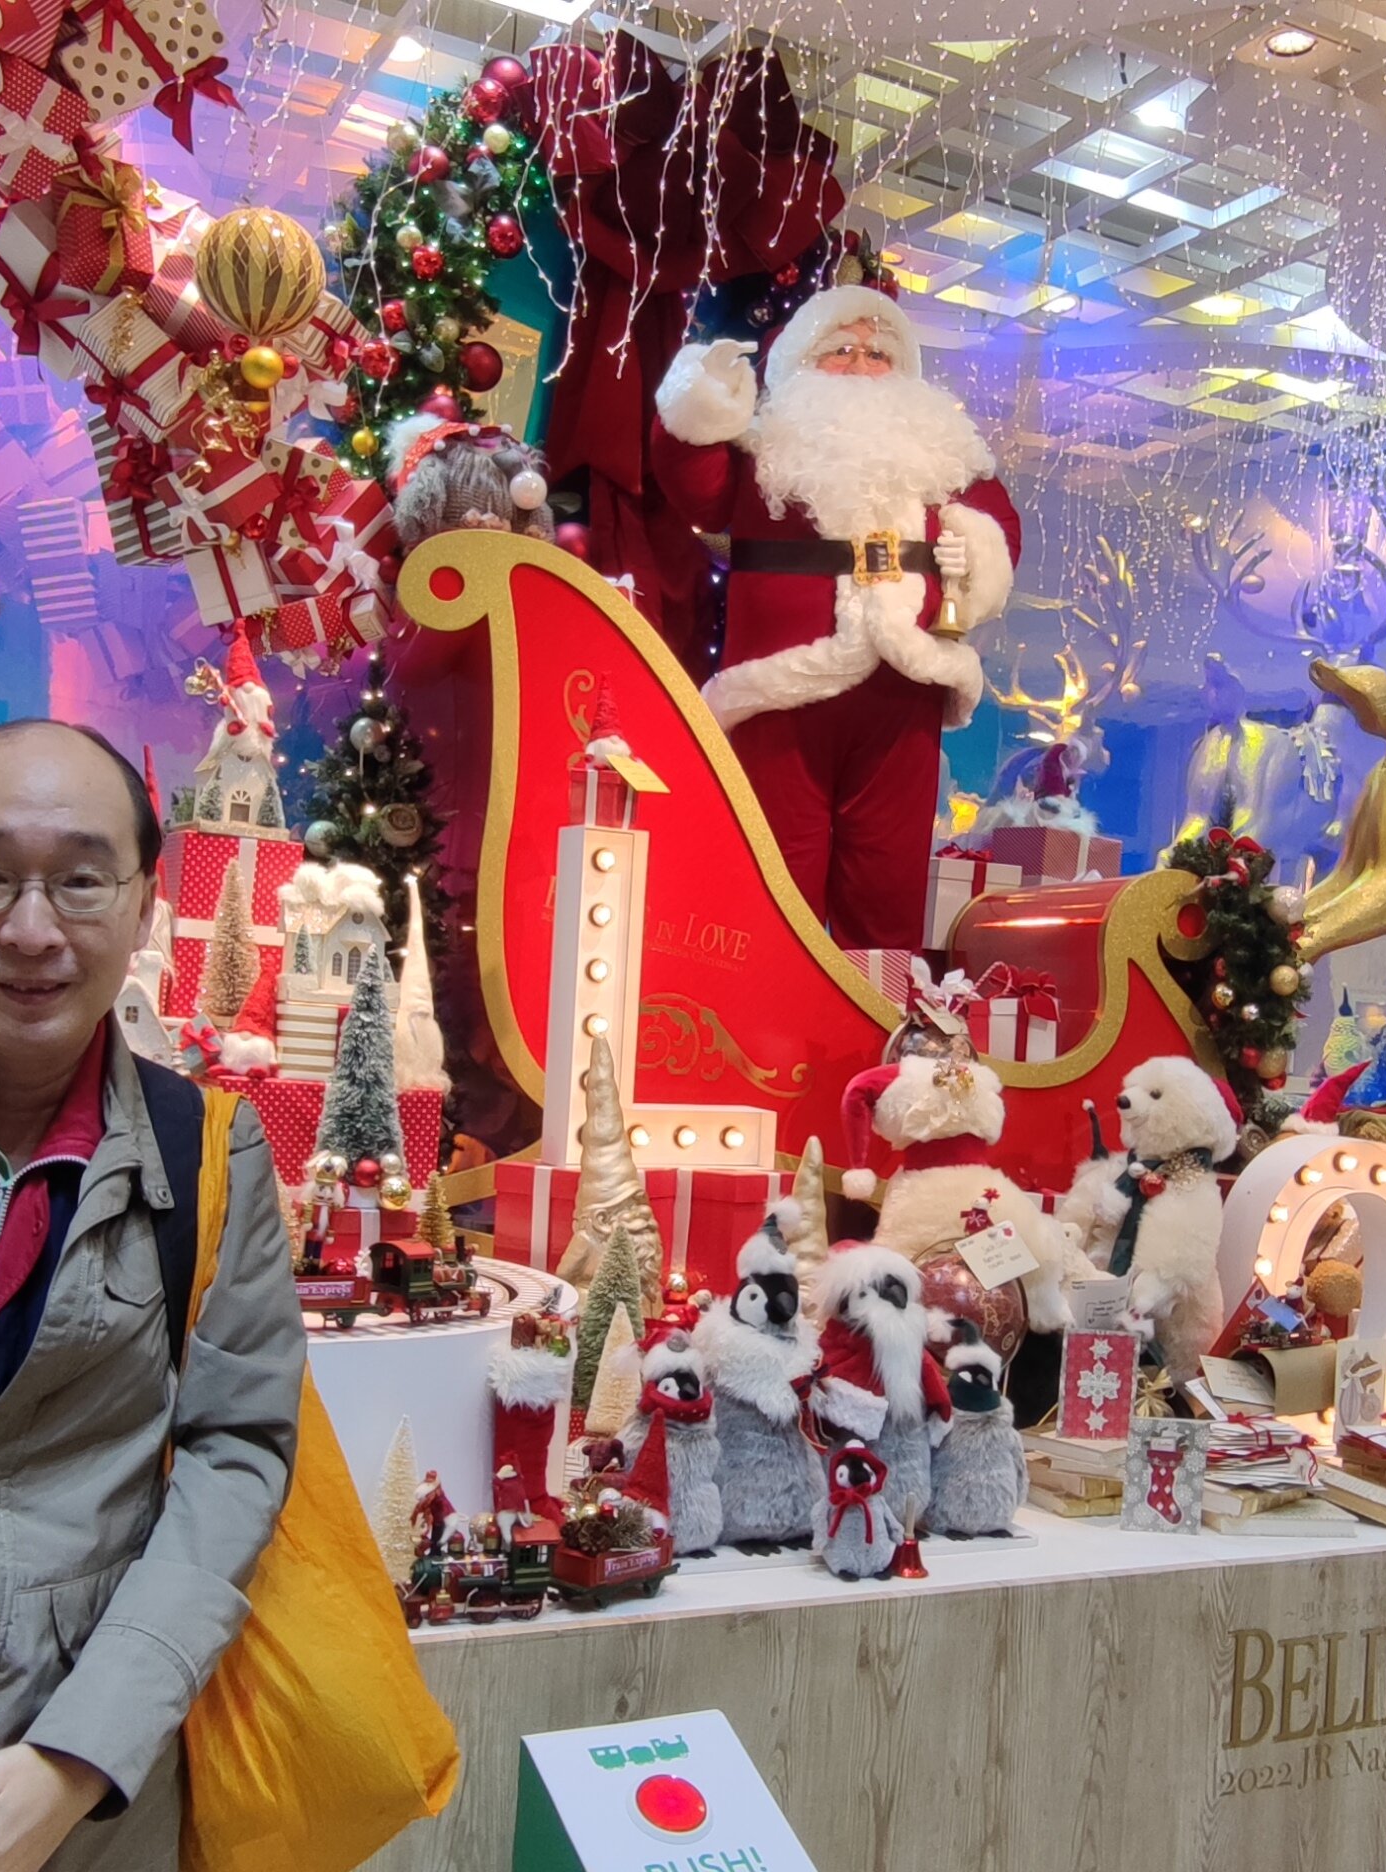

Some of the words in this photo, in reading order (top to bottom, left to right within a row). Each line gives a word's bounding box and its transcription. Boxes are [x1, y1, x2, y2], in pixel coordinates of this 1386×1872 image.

[683, 911, 751, 962] LOVE
[1219, 1762, 1293, 1798] 2022
[1297, 1742, 1334, 1790] JR
[644, 1846, 768, 1872] SH!
